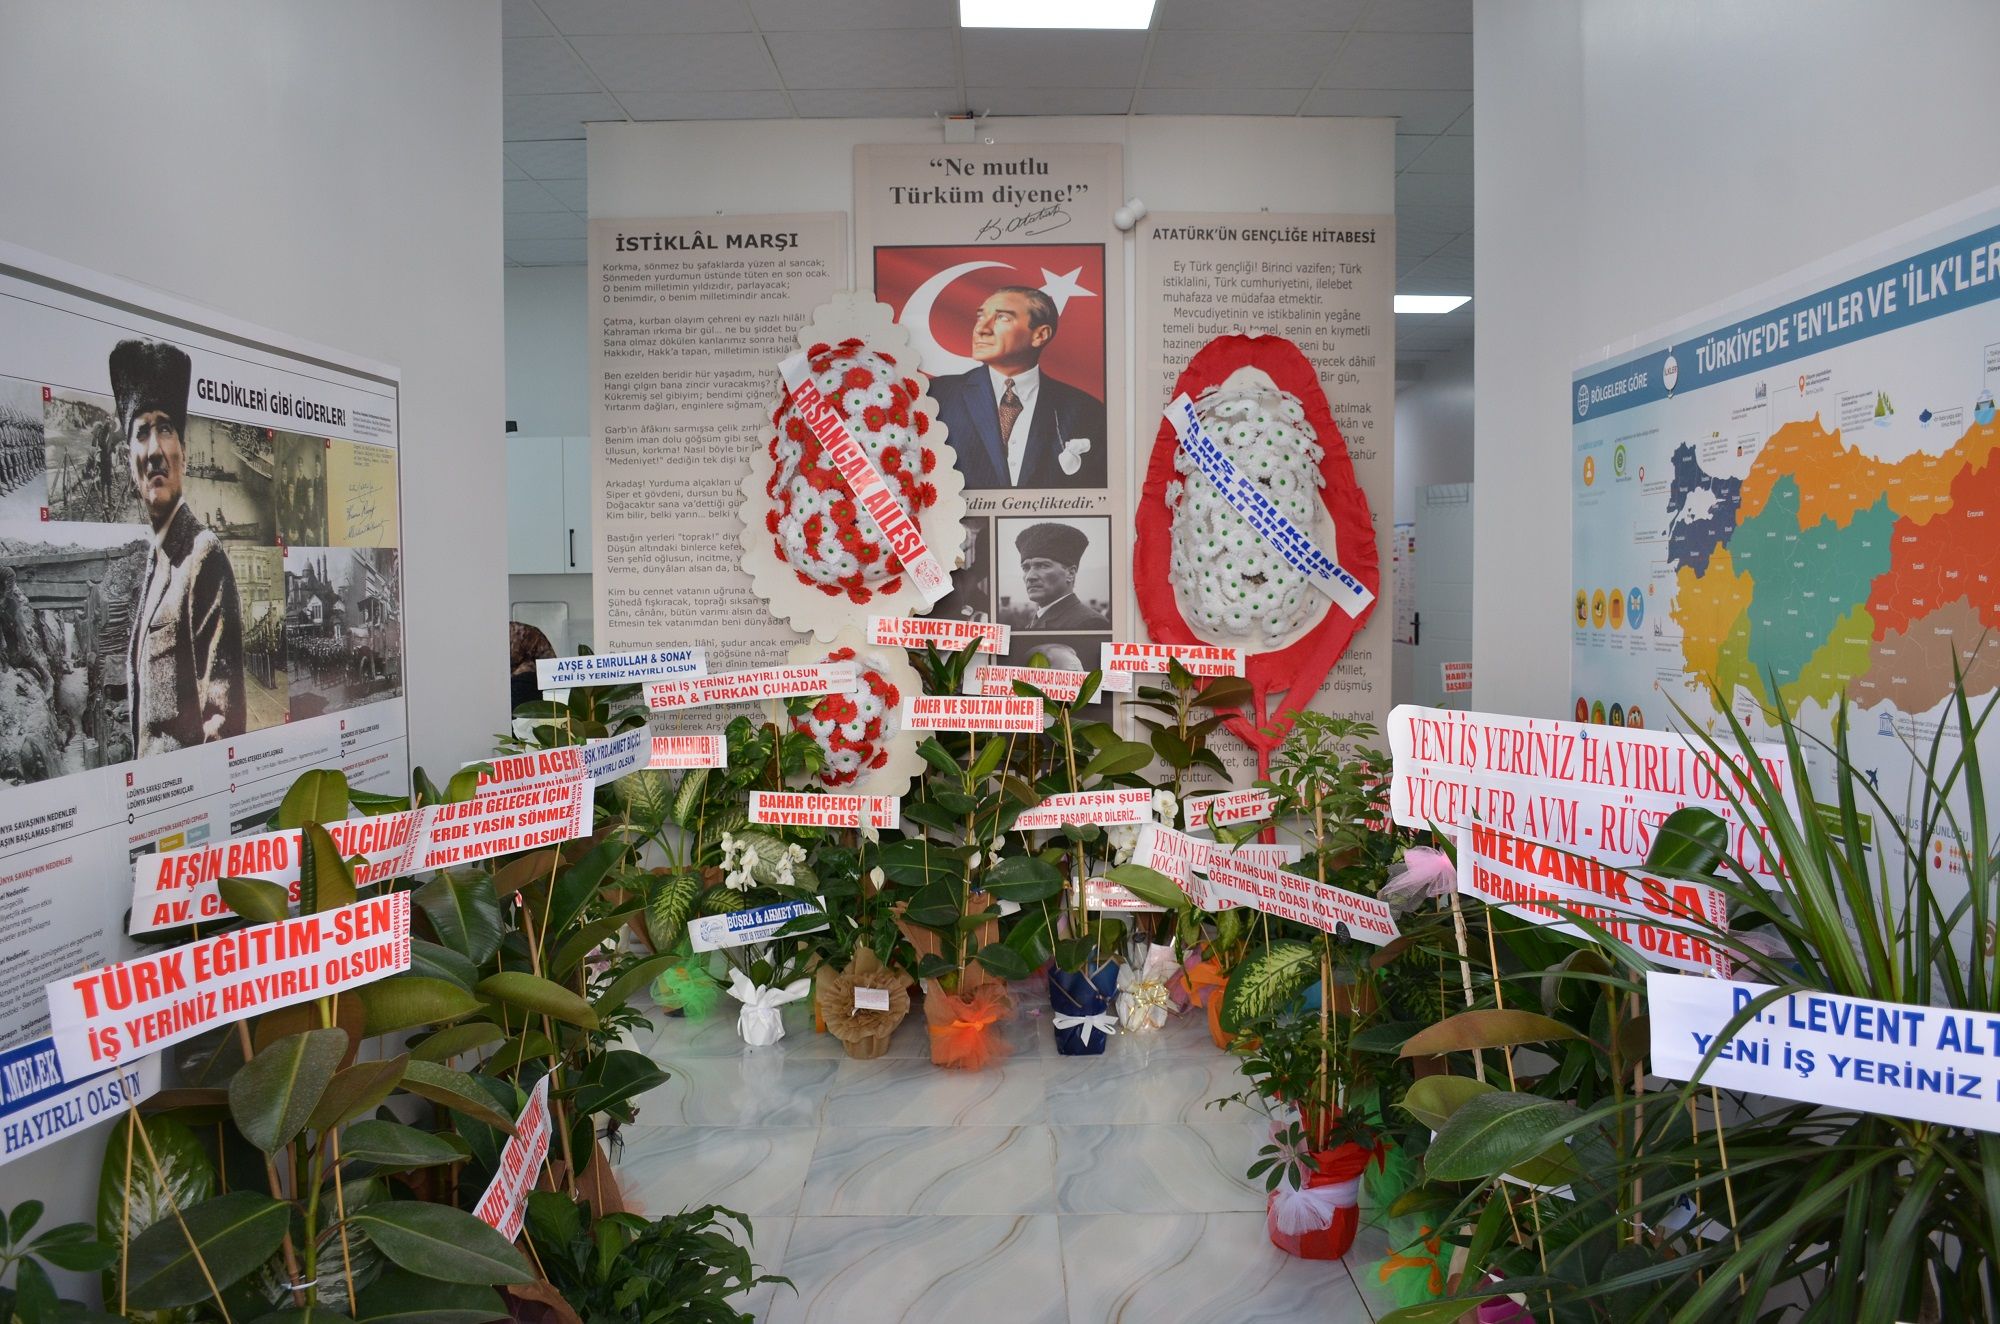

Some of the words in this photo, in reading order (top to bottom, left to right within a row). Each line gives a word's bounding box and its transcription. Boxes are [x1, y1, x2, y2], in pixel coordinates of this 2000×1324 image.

[983, 157, 1048, 176] mutlu
[890, 186, 984, 205] Türküm
[616, 231, 718, 252] İSTİKLÂL
[726, 233, 798, 251] MARŞI
[1241, 227, 1308, 245] GENÇLİĞE
[1312, 228, 1376, 244] HİTABESİ
[603, 263, 640, 272] Korkma,
[644, 261, 680, 270] sönmez
[682, 260, 694, 270] bu
[697, 260, 745, 271] şafaklarda
[748, 260, 775, 270] yüzen
[778, 258, 787, 268] al
[789, 258, 825, 268] sancak;
[1173, 261, 1186, 273] Ey
[1190, 261, 1212, 272] Türk
[1215, 261, 1258, 275] gençliği!
[1261, 262, 1293, 273] Birinci
[1296, 263, 1336, 275] vazifen;
[1340, 263, 1362, 275] Türk
[1163, 276, 1211, 289] istiklalini,
[1214, 276, 1237, 288] Türk
[1240, 277, 1313, 290] cumhuriyetini,
[1316, 279, 1353, 290] ilelebet
[1867, 277, 1897, 318] VE
[1591, 380, 1627, 404] BÖLGELERE
[1628, 372, 1648, 392] GÖRE
[196, 377, 268, 413] GELDİKLERİ
[270, 389, 292, 417] GİBİ
[295, 395, 346, 428] GİDERLER!
[878, 617, 899, 633] ALİ
[902, 619, 952, 637] ŞEVKET
[557, 659, 584, 673] AYŞE
[586, 659, 594, 670] &
[596, 655, 648, 669] EMRULLAH
[650, 654, 658, 664] &
[660, 650, 692, 662] SONAY
[1110, 643, 1237, 661] TATLIPARK
[551, 673, 574, 682] YENİ
[576, 672, 586, 681] İŞ
[589, 669, 626, 680] YERİNİZ
[628, 667, 664, 677] HAYIRLI
[666, 664, 697, 673] OLSUN
[1110, 659, 1149, 672] AKTUĞ
[1198, 664, 1236, 676] DEMİR
[651, 682, 677, 695] YENİ
[679, 681, 690, 691] İŞ
[693, 675, 735, 689] YERİNİZ
[783, 668, 819, 679] OLSUN
[651, 694, 686, 709] ESRA
[690, 692, 700, 703] &
[704, 684, 760, 701] FURKAN
[762, 679, 828, 696] ÇUHADAR
[913, 696, 941, 714] ÖNER
[944, 698, 958, 714] VE
[960, 698, 1002, 715] SULTAN
[1005, 697, 1034, 716] ÖNER
[911, 717, 929, 728] YENİ
[931, 717, 966, 728] YERİNİZ
[967, 718, 1003, 729] HAYIRLI
[1004, 719, 1034, 730] OLSUN
[670, 737, 710, 755] KALENDER
[1408, 711, 1454, 765] YENİ
[1459, 712, 1478, 774] İŞ
[1484, 719, 1576, 781] YERİNİZ
[1581, 737, 1687, 796] HAYIRLI
[538, 748, 578, 776] ACER
[593, 762, 617, 779] HAYIRLI
[618, 755, 636, 769] OLSUN
[684, 757, 711, 767] OLSUN
[458, 801, 482, 819] BİR
[486, 791, 541, 814] GELECEK
[543, 785, 570, 805] İÇİN
[759, 793, 804, 809] BAHAR
[1055, 792, 1076, 807] EVİ
[1079, 791, 1116, 807] AFŞİN
[1118, 791, 1151, 806] ŞUBE
[1216, 796, 1226, 809] İŞ
[473, 812, 521, 835] YASİN
[523, 803, 573, 826] SÖNMEZ
[757, 810, 823, 825] HAYIRLI
[827, 812, 883, 828] OLSN
[1523, 795, 1579, 846] AVM
[463, 835, 520, 858] HAYIRLI
[523, 826, 568, 847] OLSUN
[155, 842, 222, 893] AFŞİN
[227, 835, 290, 879] BARO
[1471, 822, 1632, 905] MEKANİK
[1641, 876, 1707, 926] SA
[1208, 854, 1231, 870] AŞIK
[1234, 861, 1278, 884] MAHSUNİ
[1281, 874, 1311, 894] ŞERİF
[1314, 885, 1388, 918] ORTAOKULU
[1473, 861, 1560, 920] İBRAHİM
[152, 898, 194, 926] AV.
[402, 890, 410, 916] 3521
[1209, 867, 1276, 900] ÖĞRETMENLER
[1279, 890, 1310, 909] ODASI
[1313, 902, 1356, 926] KOLTUK
[1358, 915, 1395, 936] EKİBİ
[727, 913, 755, 930] BÜŞRA
[755, 911, 763, 924] &
[764, 905, 792, 923] AHMET
[1258, 901, 1297, 920] HAYIRLI
[1300, 912, 1333, 932] OLSUN
[73, 947, 193, 1019] TÜRK
[193, 898, 392, 984] EĞİTİM-SEN
[88, 1025, 122, 1062] İŞ
[125, 991, 218, 1048] YERİNİZ
[222, 964, 319, 1014] HAYIRLI
[325, 943, 394, 986] OLSUN
[1788, 994, 1925, 1047] LEVENT
[1691, 1031, 1770, 1066] YENİ
[1783, 1041, 1816, 1079] İŞ
[1827, 1053, 1983, 1100] YERİNİZ
[3, 1096, 85, 1154] HAYIRLI
[87, 1071, 141, 1116] OLSUN
